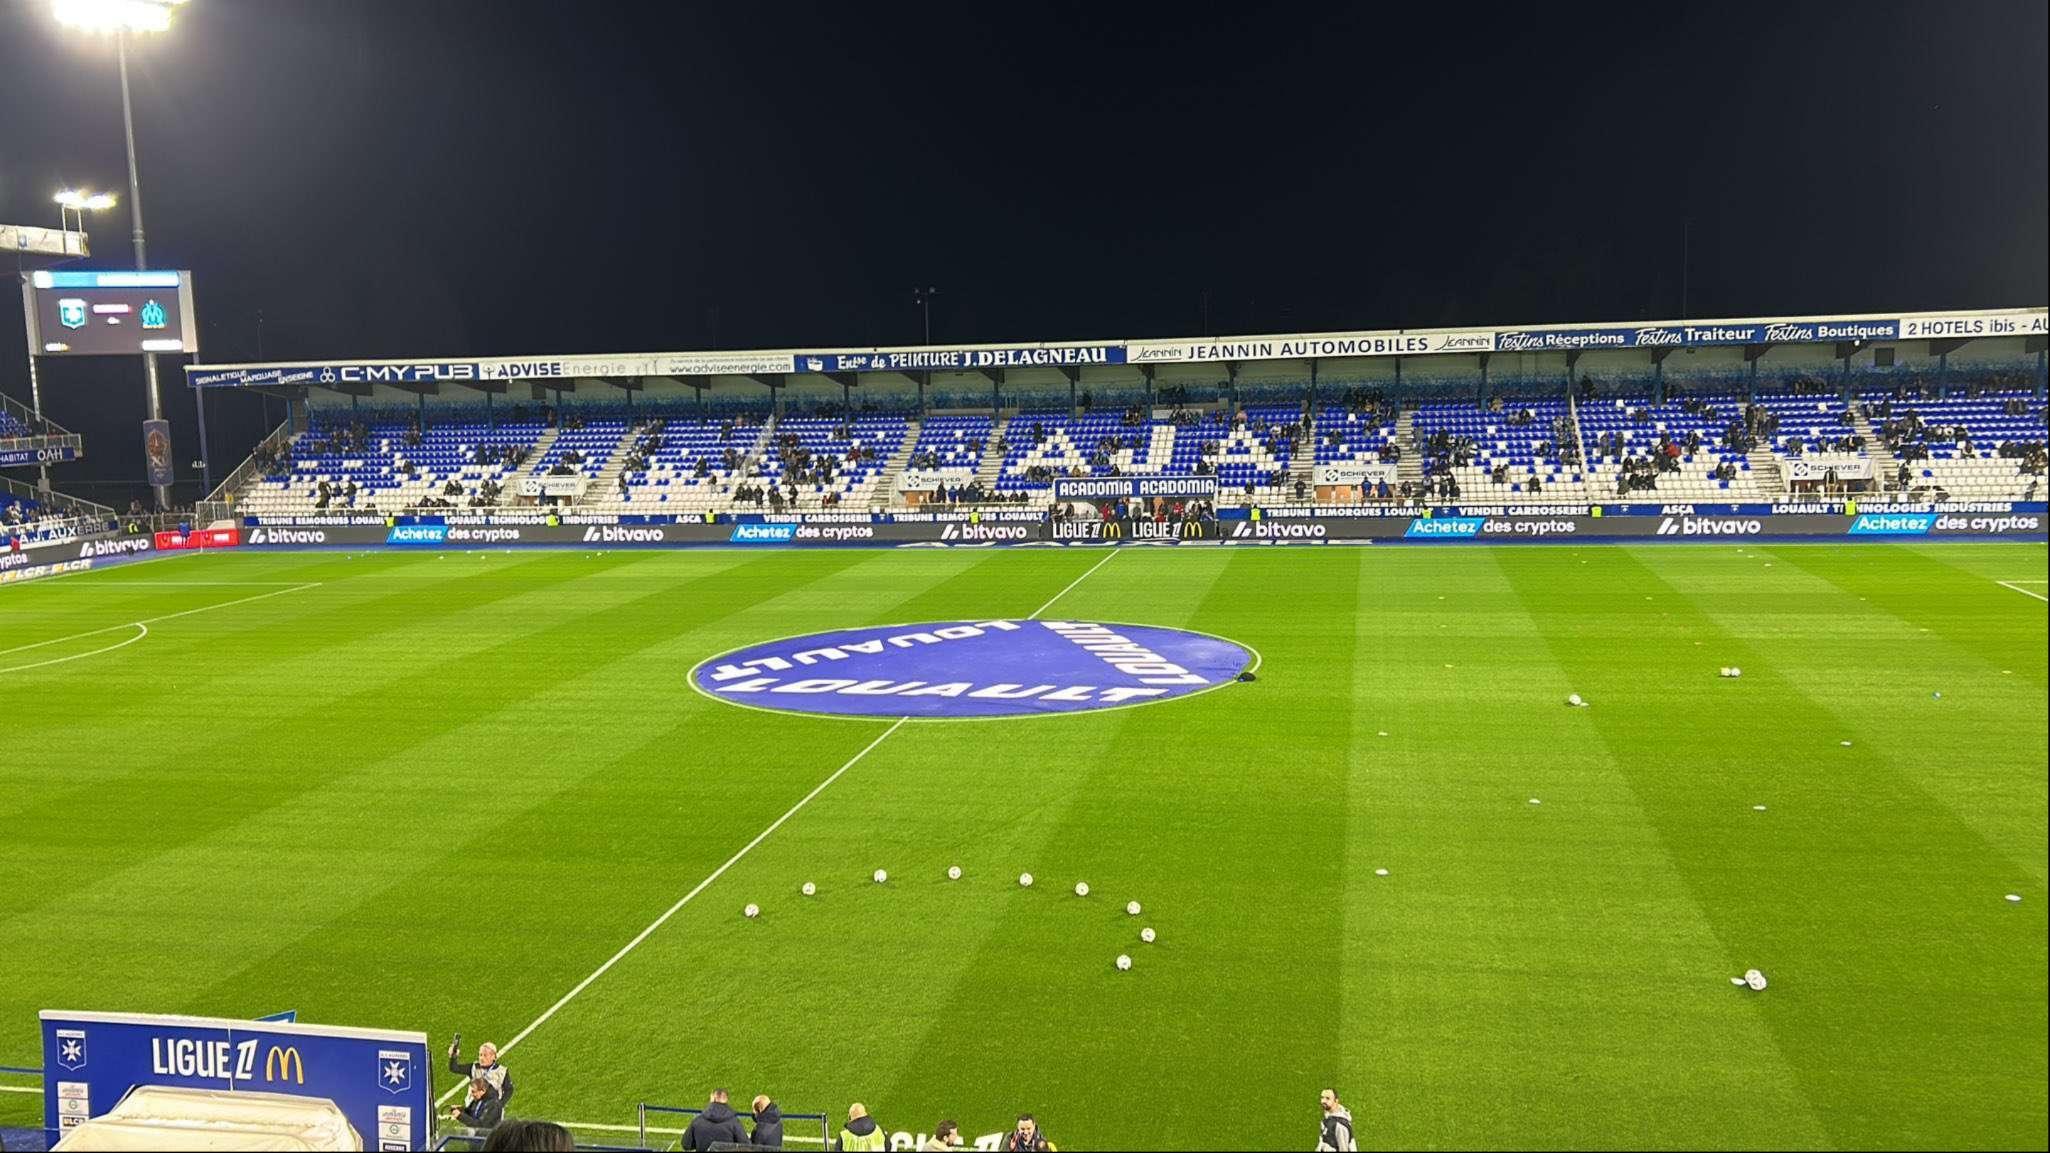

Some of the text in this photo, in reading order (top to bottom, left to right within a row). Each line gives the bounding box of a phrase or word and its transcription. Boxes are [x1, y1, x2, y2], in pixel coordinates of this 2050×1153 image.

[1764, 323, 1894, 341] Festins Boutiques
[1908, 322, 1917, 336] 2
[1922, 320, 1983, 335] HOTELS
[1989, 318, 2016, 333] ibis
[1498, 331, 1625, 349] Festins Réceptions
[1635, 327, 1755, 346] Festins Traiteur
[1188, 337, 1429, 359] JEANNIN AUTOMOBILES
[871, 354, 887, 368] de
[890, 352, 959, 367] PEINTURE
[415, 364, 473, 381] PUB
[497, 361, 627, 378] ADVISE Energie
[1810, 464, 1862, 472] SCHEVER
[1059, 478, 1216, 497] ACADOMIA ACADOMIA
[1265, 508, 1312, 518] TRIBUNE
[1314, 508, 1381, 518] REMORQUES
[1459, 505, 1589, 516] VENDEE CARROSSERIE
[1771, 503, 1829, 514] LOUAULT
[1933, 501, 2012, 513] INDUSTRIES
[258, 516, 293, 526] TRIBUNE
[295, 516, 349, 526] REMORQUES
[444, 515, 619, 525] LOUAULT TECHNOLOG INDUSTRIES
[804, 514, 872, 523] CARROSSERIE
[893, 512, 1043, 522] TRIBUNE REMORUES LOUAULT
[1857, 515, 2039, 533] Achetez des cryptos
[49, 522, 109, 540] AUXERRE
[393, 527, 520, 542] Achetez des cryptos
[602, 526, 664, 541] bitvavo
[737, 525, 874, 540] Achetez des cryptos
[962, 524, 1027, 540] bitvavo
[1052, 522, 1089, 539] LIGUE
[1132, 522, 1170, 538] LIGUE
[1256, 521, 1326, 538] bitvavo
[1413, 518, 1576, 536] Achetez des cryptos
[1683, 517, 1761, 535] bitvavo
[268, 528, 325, 543] bitvavo
[95, 538, 150, 555] bitvavo
[715, 677, 1171, 703] LOUAULT
[152, 1038, 233, 1079] LIGUE
